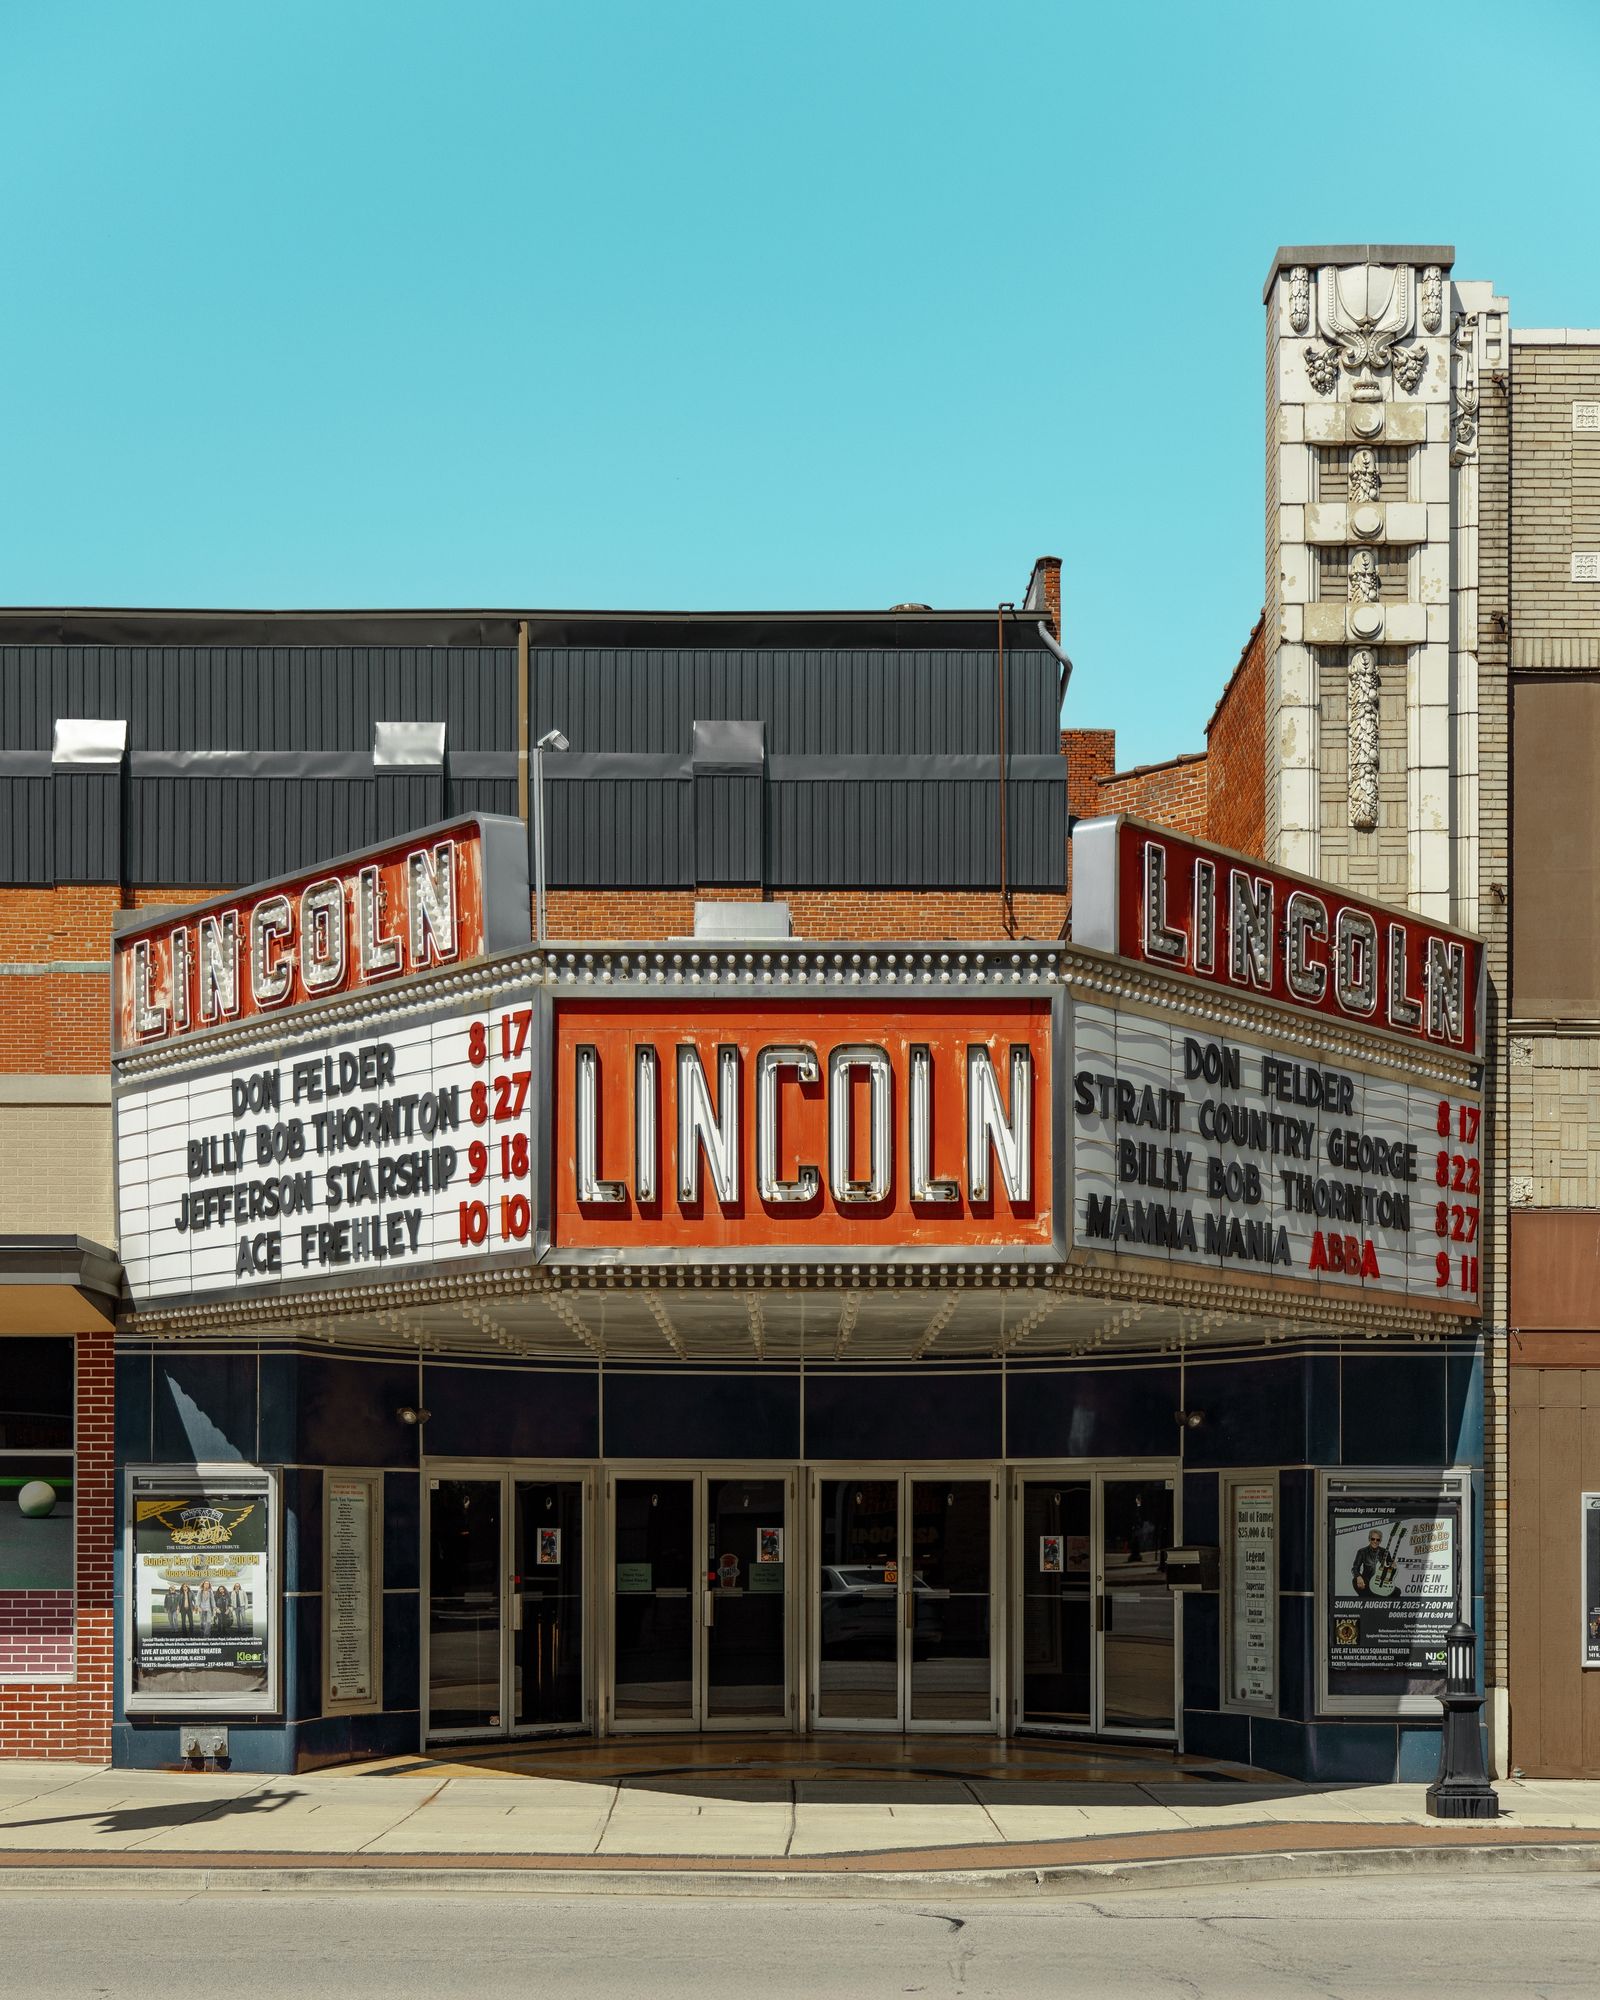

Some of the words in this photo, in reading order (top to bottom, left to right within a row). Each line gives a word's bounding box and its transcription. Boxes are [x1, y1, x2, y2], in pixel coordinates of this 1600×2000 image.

[133, 839, 459, 1042] LINCOLN
[1143, 839, 1466, 1045] LINCOLN
[232, 1068, 280, 1118] DON
[292, 1042, 396, 1105] FELDER
[468, 1021, 487, 1066] 8
[501, 1008, 532, 1060] 17
[1184, 1036, 1240, 1090] DON
[1261, 1055, 1354, 1116] FELDER
[1436, 1100, 1451, 1138] 8
[1459, 1105, 1481, 1145] 17
[187, 1128, 246, 1178] BILLY
[256, 1117, 306, 1165] BOB
[311, 1084, 460, 1154] THORNTON
[469, 1080, 489, 1125] 8
[493, 1070, 532, 1122] 27
[575, 1043, 1031, 1202] LINCOLN
[1074, 1070, 1185, 1133] STRAIT
[1198, 1099, 1315, 1161] COUNTRY
[1327, 1127, 1418, 1183] GEORGE
[1436, 1150, 1450, 1188] 8
[1451, 1154, 1481, 1195] 22
[174, 1170, 313, 1234] JEFFERSON
[325, 1144, 457, 1208] STARSHIP
[468, 1140, 488, 1185] 9
[501, 1132, 530, 1182] 18
[1118, 1137, 1193, 1193] BILLY
[1206, 1156, 1261, 1205] BOB
[1280, 1169, 1411, 1232] THORNTON
[1435, 1201, 1449, 1238] 8
[1451, 1204, 1480, 1243] 27
[236, 1230, 282, 1277] ACE
[300, 1207, 422, 1267] FREHLEY
[459, 1199, 489, 1246] 10
[500, 1193, 531, 1240] 10
[1086, 1193, 1198, 1253] MAMMA
[1203, 1212, 1293, 1267] MANIA
[1308, 1231, 1381, 1279] ABBA
[1435, 1251, 1450, 1288] 9
[1461, 1254, 1479, 1294] 11
[143, 1556, 173, 1568] Sunday
[173, 1556, 191, 1568] May
[1245, 1550, 1265, 1563] Legend
[1336, 1525, 1358, 1535] Formerly
[1371, 1518, 1390, 1527] EAGLES
[1419, 1521, 1445, 1533] Show
[1334, 1600, 1363, 1610] SUNDAY,
[1364, 1600, 1392, 1609] AUGUST
[1392, 1600, 1401, 1609] 17,
[1402, 1600, 1420, 1609] 2025
[1425, 1600, 1441, 1609] 7:00
[1441, 1601, 1454, 1609] PM
[1388, 1611, 1407, 1619] DOORS
[1407, 1611, 1423, 1619] OPEN
[1423, 1611, 1431, 1619] AT
[1431, 1611, 1444, 1619] 6:00
[1444, 1611, 1454, 1619] PM
[1404, 1584, 1448, 1594] CONCERT!
[1411, 1574, 1430, 1583] LIVE
[1431, 1574, 1442, 1583] IN
[1336, 1619, 1358, 1627] LADY
[1336, 1636, 1358, 1645] LUCK
